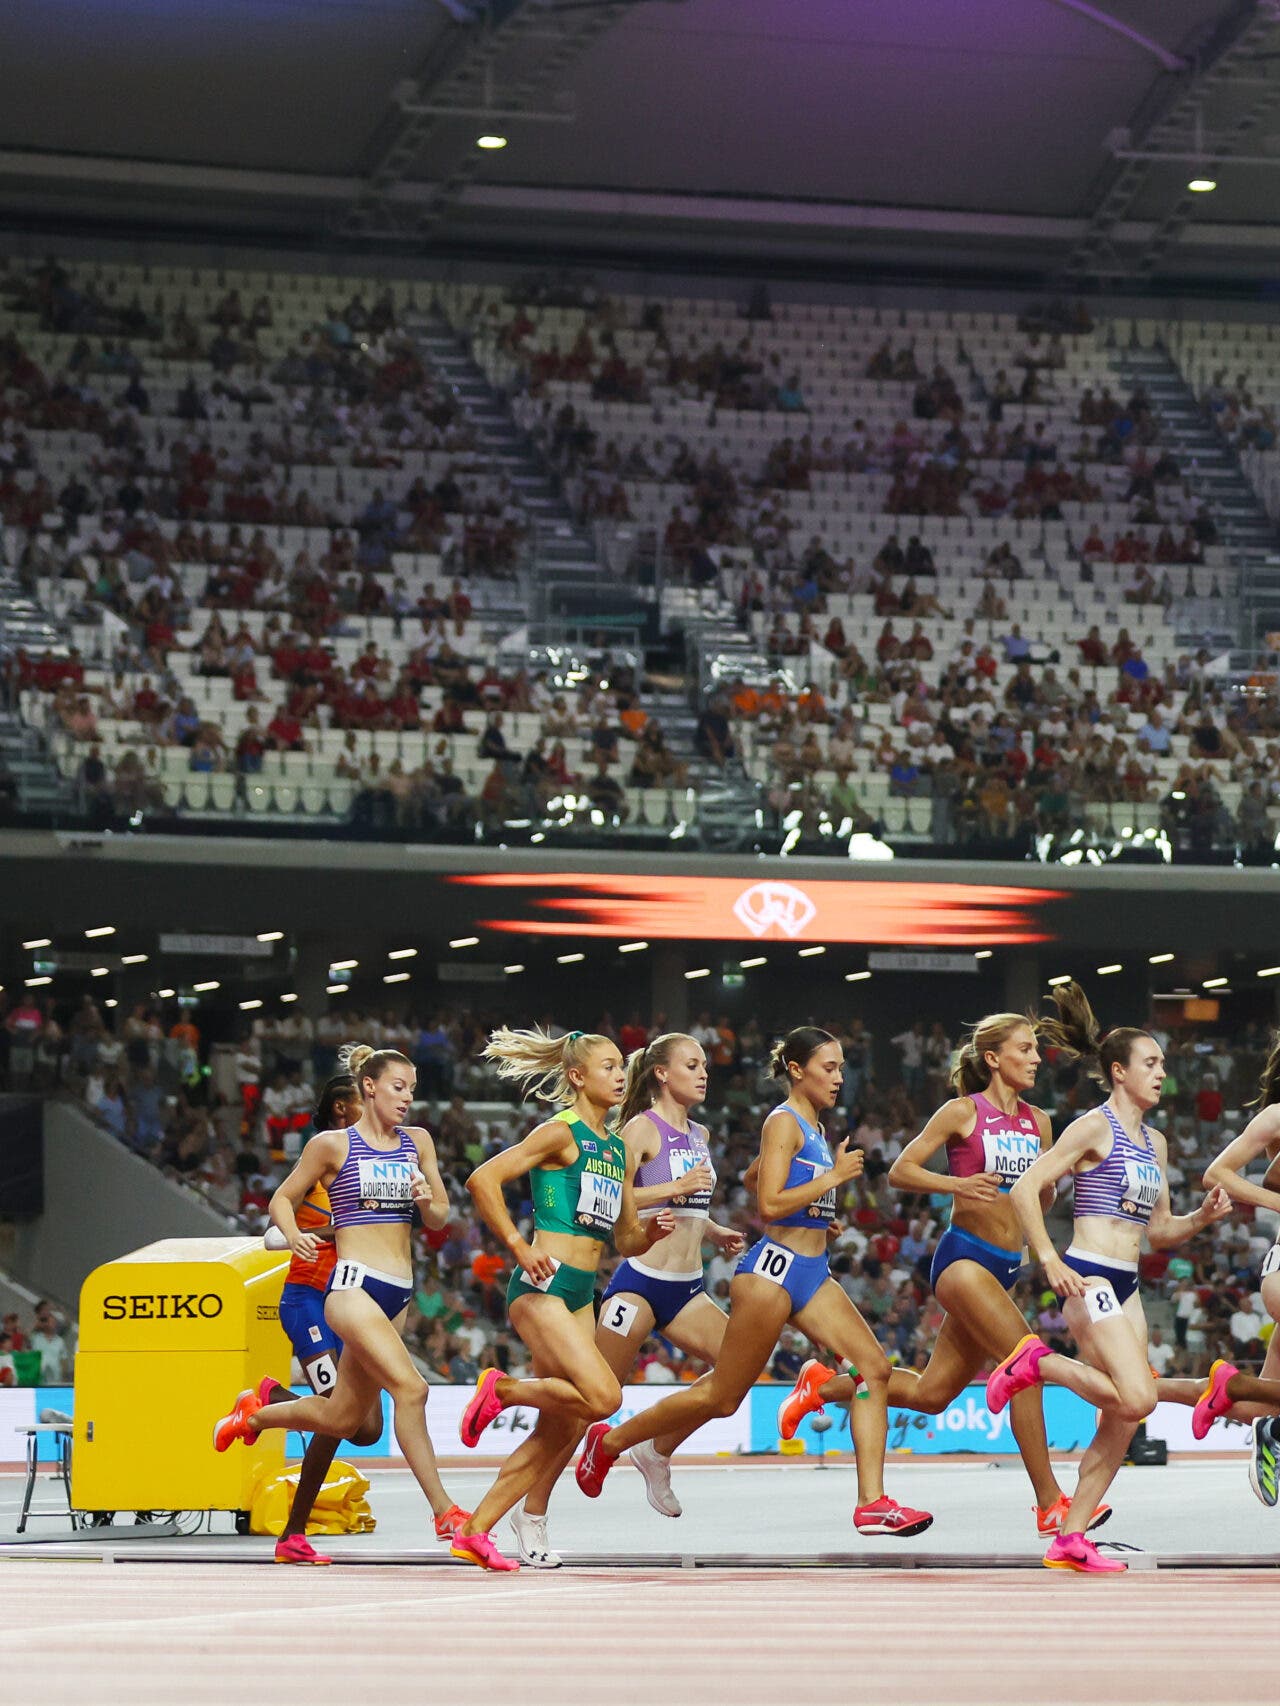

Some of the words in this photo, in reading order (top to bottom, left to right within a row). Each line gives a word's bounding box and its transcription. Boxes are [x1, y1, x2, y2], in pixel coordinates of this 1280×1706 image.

[996, 1136, 1039, 1154] NTN
[373, 1163, 414, 1179] NTN
[995, 1156, 1037, 1173] McGE
[1137, 1165, 1161, 1185] NTN
[363, 1182, 412, 1197] COURTNEY-BR
[592, 1177, 620, 1200] NTN
[593, 1196, 613, 1218] HULL
[761, 1248, 787, 1278] 10
[341, 1265, 360, 1287] 11
[103, 1293, 223, 1320] SEIKO
[256, 1305, 279, 1320] SEIK
[1095, 1291, 1114, 1313] 8
[611, 1305, 627, 1328] 5
[316, 1363, 331, 1385] 6
